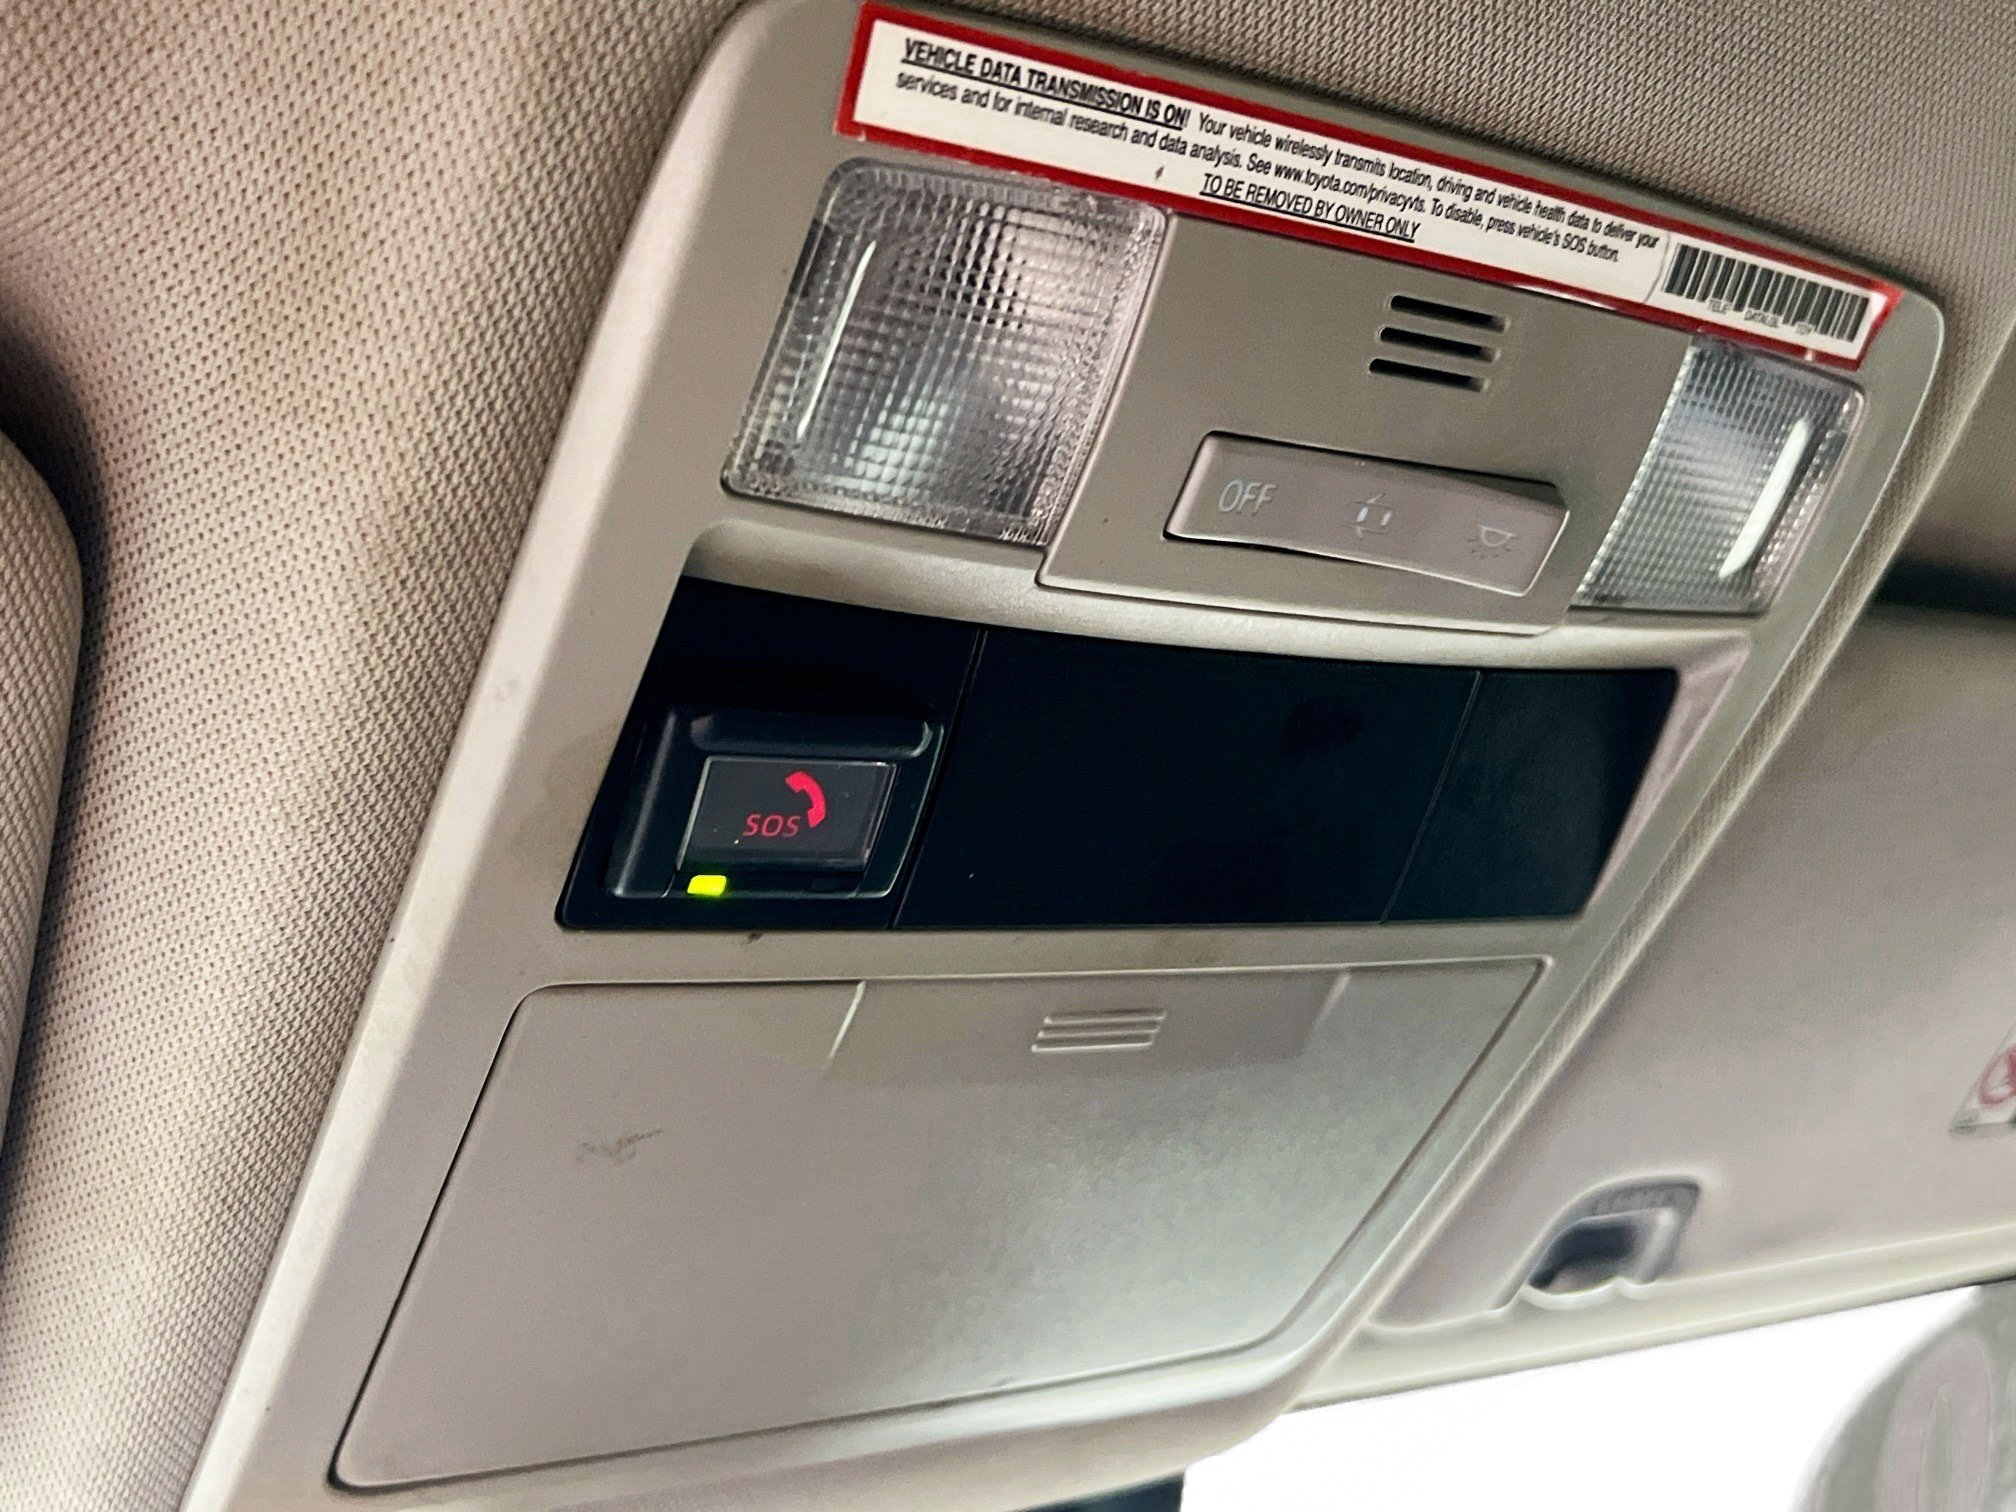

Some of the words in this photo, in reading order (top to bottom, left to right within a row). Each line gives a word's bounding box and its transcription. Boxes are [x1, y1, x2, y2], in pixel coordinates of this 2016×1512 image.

[896, 72, 959, 101] services
[961, 88, 991, 108] and
[992, 90, 1014, 112] for
[1014, 96, 1069, 126] internal
[1069, 112, 1128, 146] research
[1130, 128, 1158, 148] and
[1158, 132, 1188, 155] data
[1189, 143, 1242, 169] analysis.
[1246, 152, 1272, 175] See
[1430, 197, 1444, 216] To
[1444, 203, 1484, 230] disable,
[1485, 216, 1516, 235] press
[1561, 232, 1587, 253] SOS
[905, 38, 977, 74] VEHICLE
[980, 57, 1021, 86] DATA
[1027, 68, 1144, 114] TRANSMISSION
[1145, 98, 1162, 120] IS
[1199, 112, 1227, 135] Your
[1229, 124, 1272, 148] vehicle
[1275, 134, 1333, 167] wirelessly
[1334, 148, 1386, 177] transmits
[1388, 162, 1433, 191] location,
[1436, 175, 1473, 202] driving
[1474, 188, 1497, 205] and
[1497, 193, 1532, 214] vehicle
[1533, 200, 1566, 223] health
[1567, 210, 1590, 230] data
[1591, 217, 1603, 233] to
[1603, 220, 1638, 242] deliver
[1635, 232, 1660, 249] your
[1203, 173, 1222, 194] TO
[1224, 178, 1245, 199] BE
[1245, 183, 1313, 214] REMOVED
[1314, 200, 1334, 219] BY
[1334, 204, 1384, 231] OWNER
[1385, 216, 1421, 239] ONLY
[1218, 479, 1278, 515] OFF
[742, 813, 801, 837] SOS
